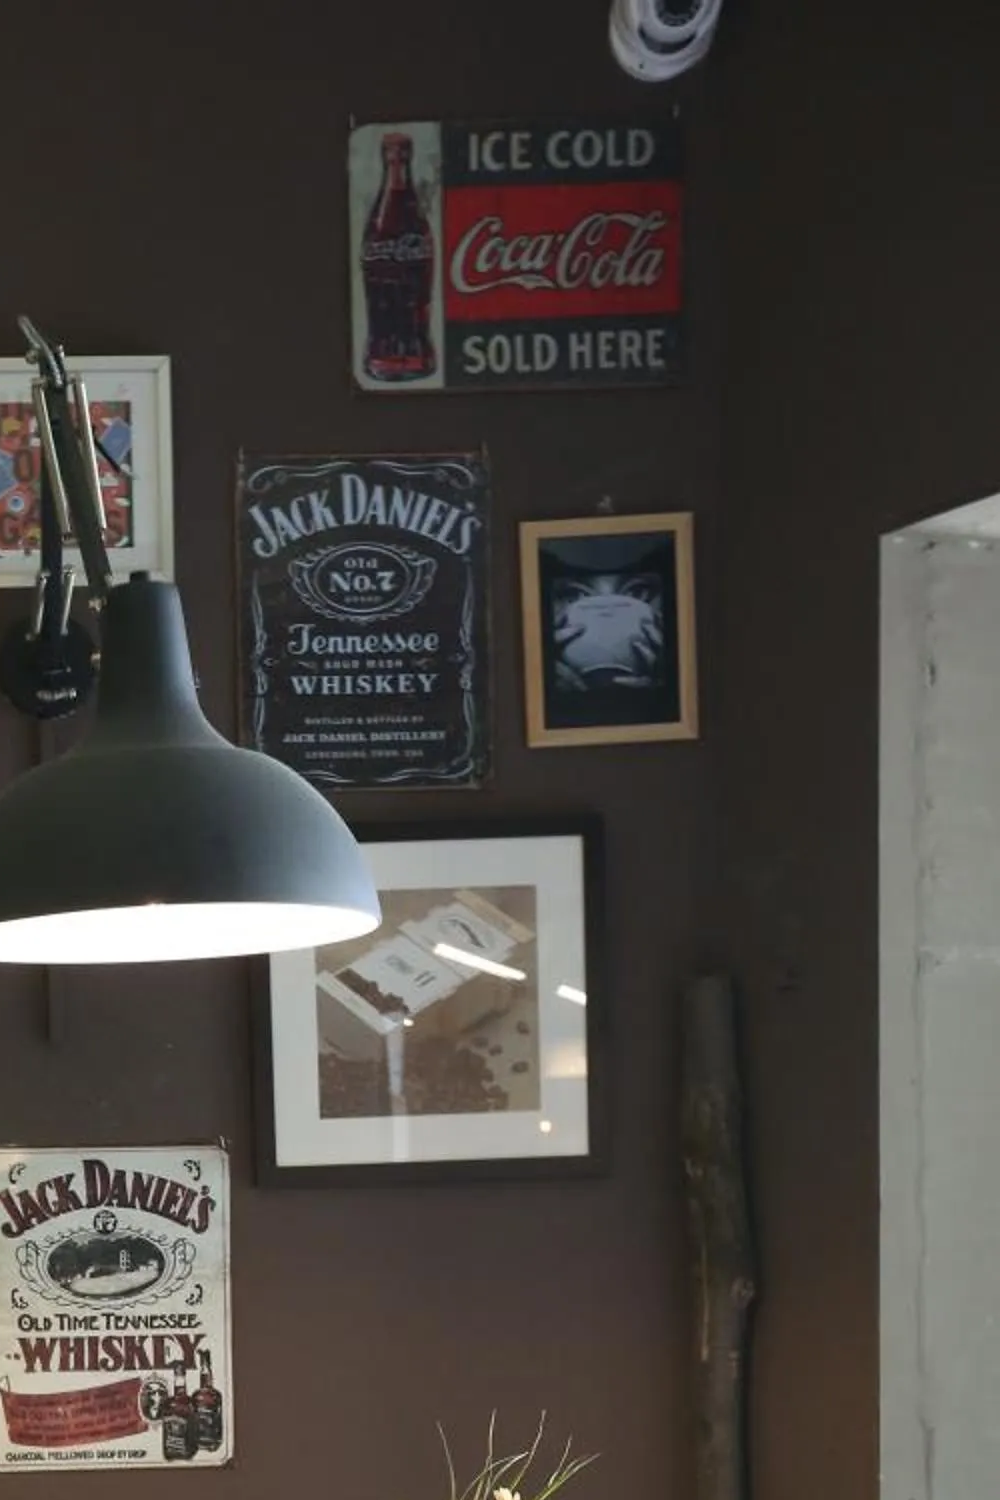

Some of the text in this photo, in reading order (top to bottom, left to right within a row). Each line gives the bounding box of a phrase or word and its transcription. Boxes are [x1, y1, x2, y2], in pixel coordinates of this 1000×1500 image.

[469, 129, 655, 171] ICE COLD
[450, 212, 666, 293] Coca-Cola
[463, 329, 666, 373] SOLD HERE
[248, 473, 481, 557] JACK DANIEL'S
[343, 557, 378, 569] Old
[287, 624, 440, 655] Tennessee
[290, 674, 441, 696] WHISKEY
[79, 1159, 216, 1235] DANIEL'S
[17, 1313, 202, 1332] OLD TIME TENNESSEE
[18, 1334, 207, 1373] WHISKEY
